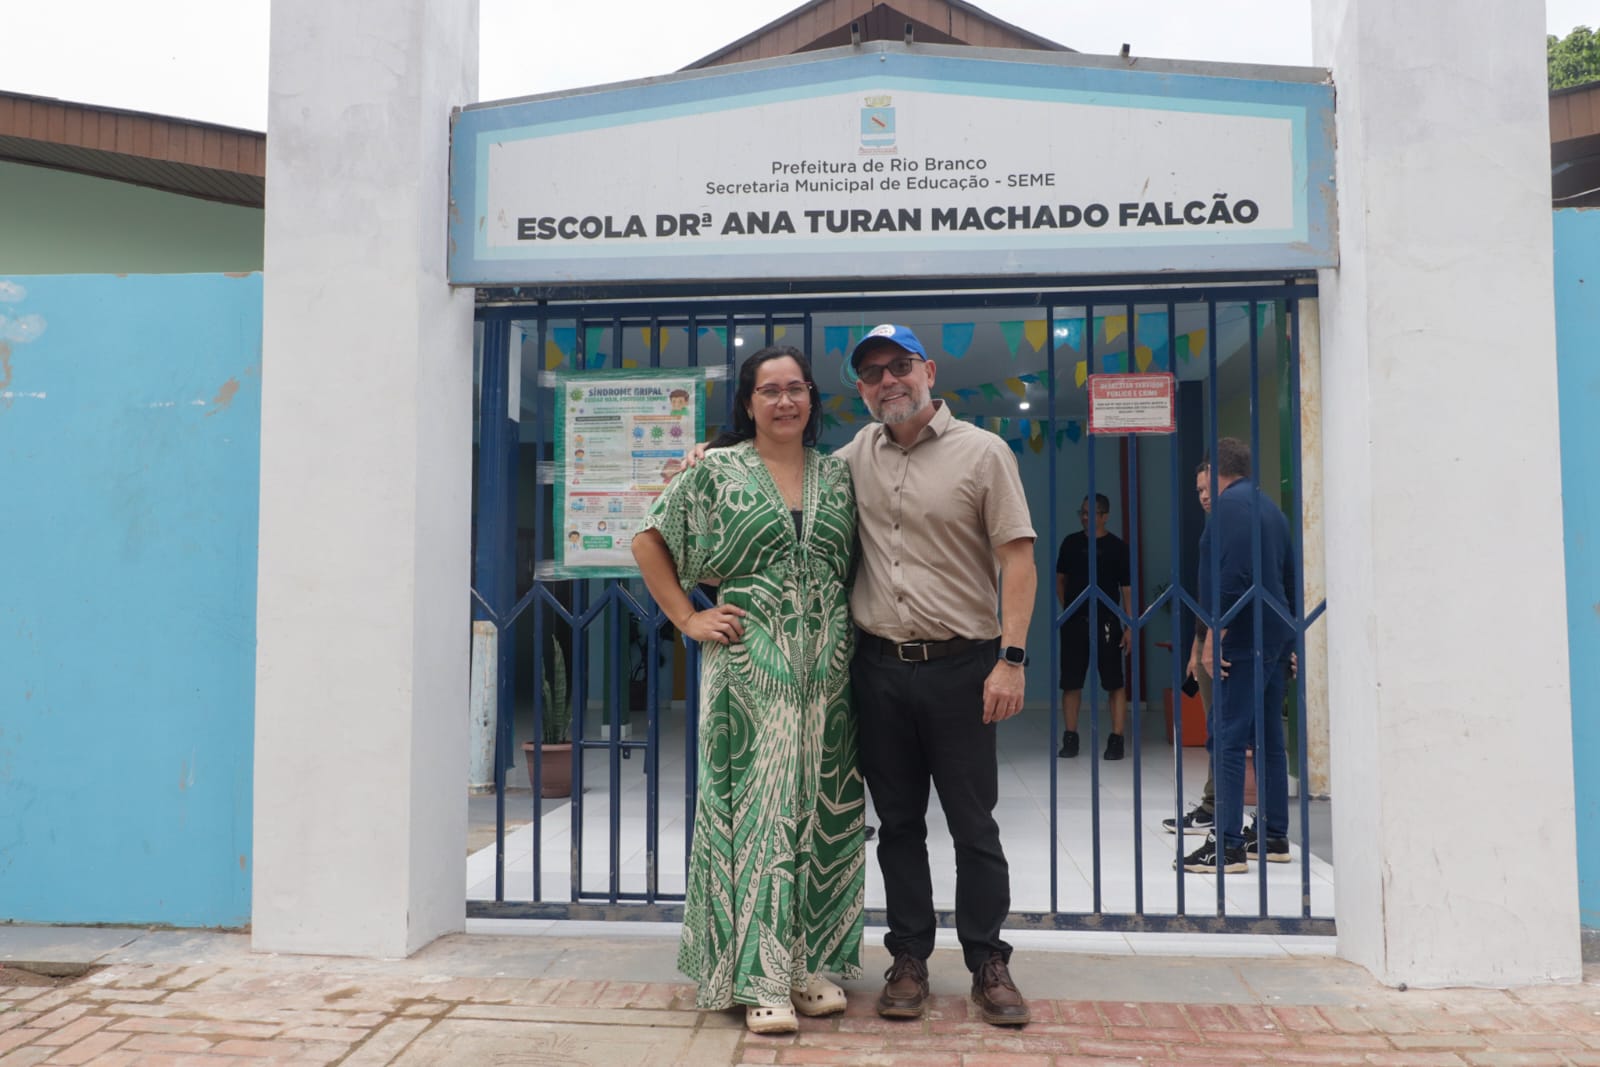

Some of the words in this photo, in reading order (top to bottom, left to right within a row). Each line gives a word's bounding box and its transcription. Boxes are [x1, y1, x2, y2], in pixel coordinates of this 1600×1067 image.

[771, 160, 857, 175] Prefeitura
[862, 158, 885, 173] de
[890, 157, 919, 172] Rio
[925, 157, 987, 171] Branco
[706, 179, 790, 195] Secretaria
[795, 177, 874, 194] Municipal
[879, 177, 901, 190] de
[906, 175, 990, 191] Educação
[1007, 173, 1056, 188] SEME
[517, 214, 648, 241] ESCOLA
[720, 210, 796, 235] ANA
[804, 208, 922, 234] TURAN
[931, 203, 1110, 231] MACHADO
[1118, 192, 1260, 227] FALCÃO
[588, 387, 632, 397] SÍNDROME
[634, 387, 662, 396] GRIPAL
